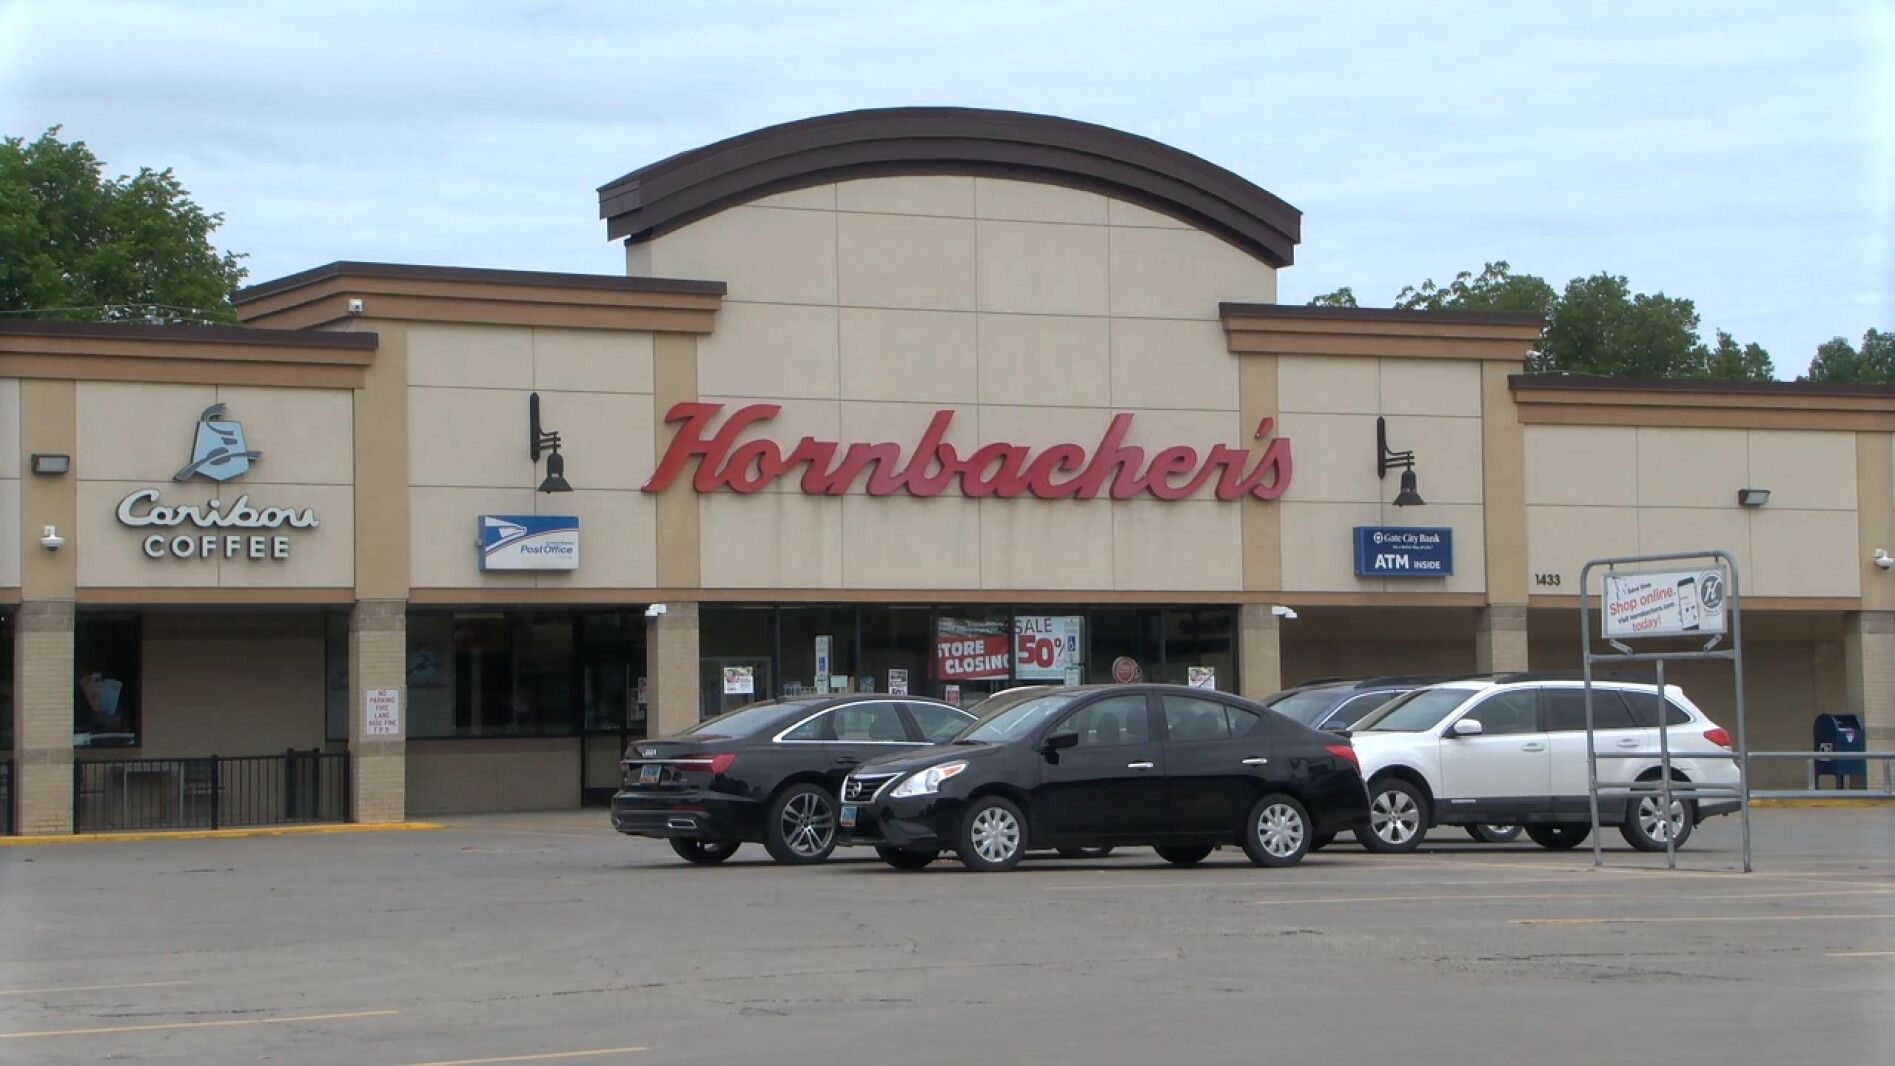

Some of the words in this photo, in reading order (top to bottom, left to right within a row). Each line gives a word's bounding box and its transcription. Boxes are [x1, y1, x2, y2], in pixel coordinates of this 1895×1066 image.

[641, 403, 1293, 499] Hornbacher's
[117, 489, 319, 528] Caribou
[143, 534, 289, 559] COFFEE
[1384, 533, 1402, 543] Gate
[1403, 533, 1418, 546] City
[1420, 533, 1440, 543] Bank
[520, 544, 542, 555] Post
[544, 544, 574, 555] Office
[1374, 554, 1409, 569] ATM
[1413, 560, 1441, 569] INSIDE
[1535, 573, 1561, 586] 1433
[1610, 599, 1637, 616] Shop
[1640, 587, 1677, 606] online.
[1013, 618, 1052, 634] SALE
[1632, 613, 1662, 632] today!
[1018, 634, 1066, 668] 50%
[370, 696, 396, 704] PARKING
